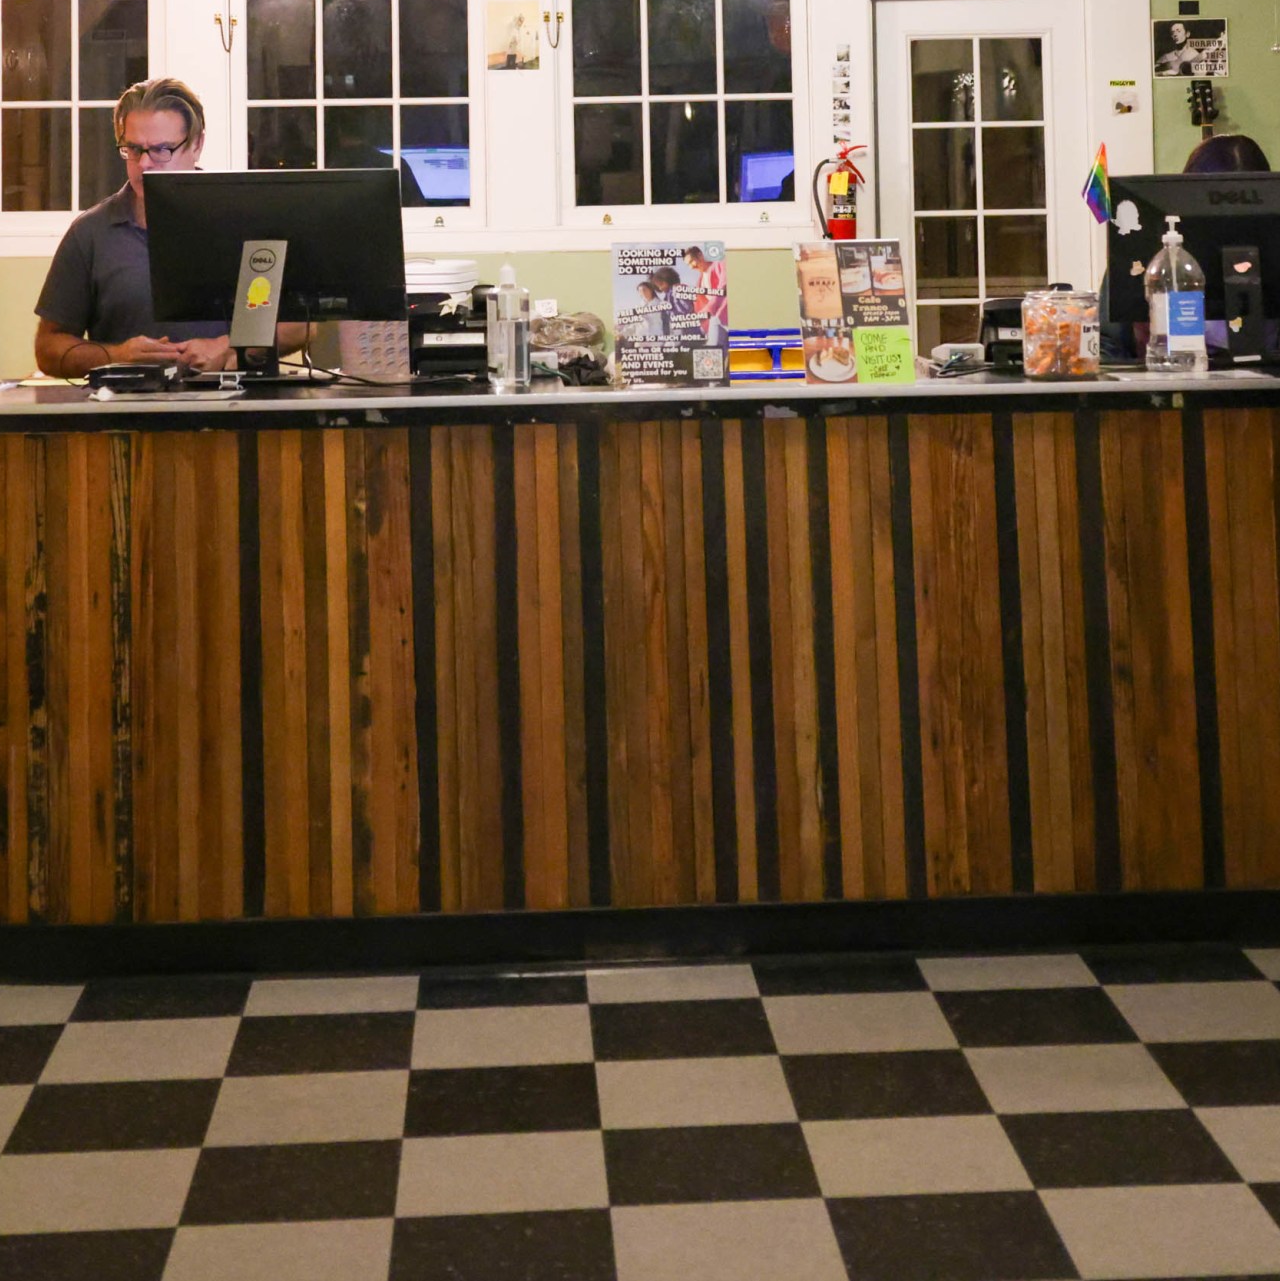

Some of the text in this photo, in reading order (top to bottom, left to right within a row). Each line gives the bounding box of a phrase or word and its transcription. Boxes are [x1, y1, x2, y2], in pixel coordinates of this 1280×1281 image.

[1189, 40, 1223, 48] BORROW
[1205, 51, 1224, 60] THIS
[1194, 63, 1224, 71] GUITAR
[618, 249, 683, 258] LOOKING FOR
[618, 257, 673, 266] SOMETHING
[618, 266, 653, 274] DO TO?
[676, 285, 724, 296] GUIDED BIKE
[675, 292, 697, 301] RIDES
[635, 302, 673, 315] WALKING
[618, 316, 643, 324] TOURS
[670, 312, 708, 322] WELCOME
[671, 320, 700, 329] PARTIES
[860, 333, 888, 344] COME
[864, 344, 886, 353] AND
[621, 353, 664, 361] ACTIVITIES
[861, 354, 884, 365] VISIT
[621, 361, 641, 369] AND
[622, 377, 631, 385] by
